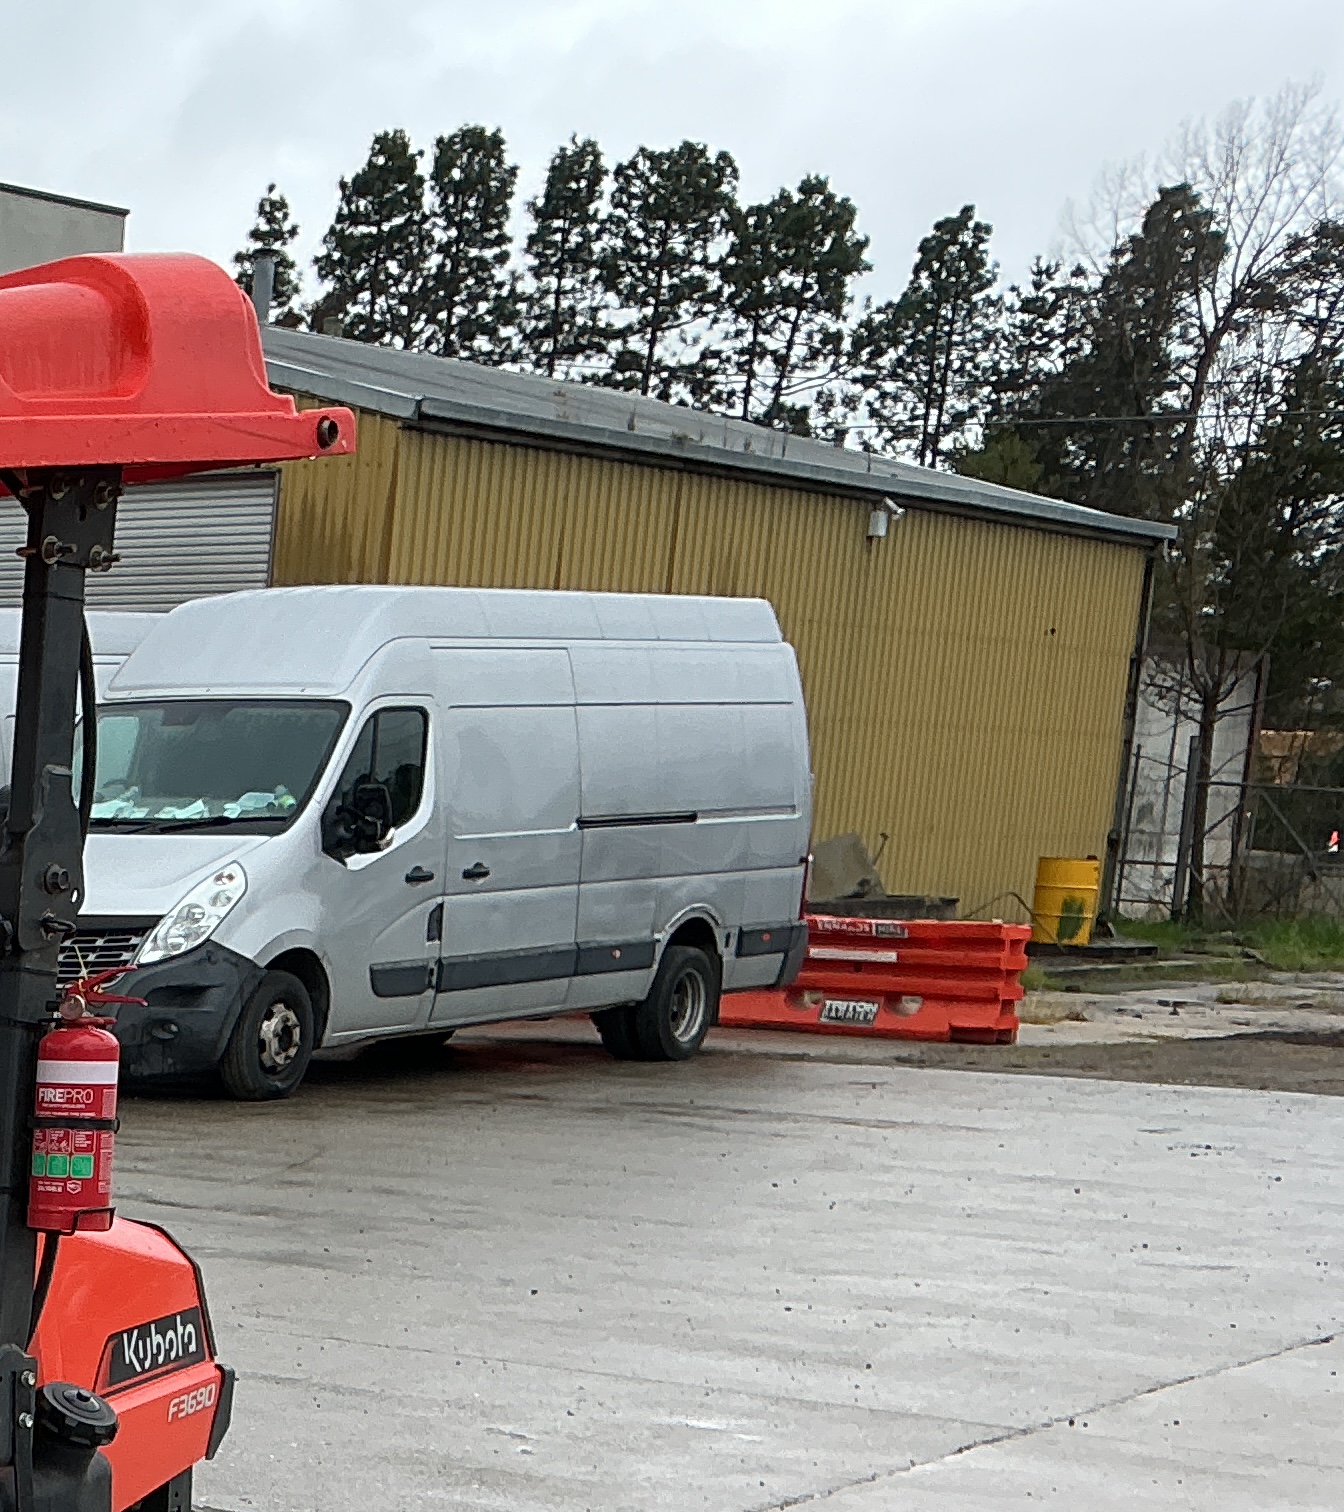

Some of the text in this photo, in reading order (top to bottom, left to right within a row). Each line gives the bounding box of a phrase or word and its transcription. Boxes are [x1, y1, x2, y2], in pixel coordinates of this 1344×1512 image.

[38, 1087, 94, 1104] FIREPRO
[122, 1314, 197, 1373] Kubota
[167, 1383, 216, 1423] F3690
